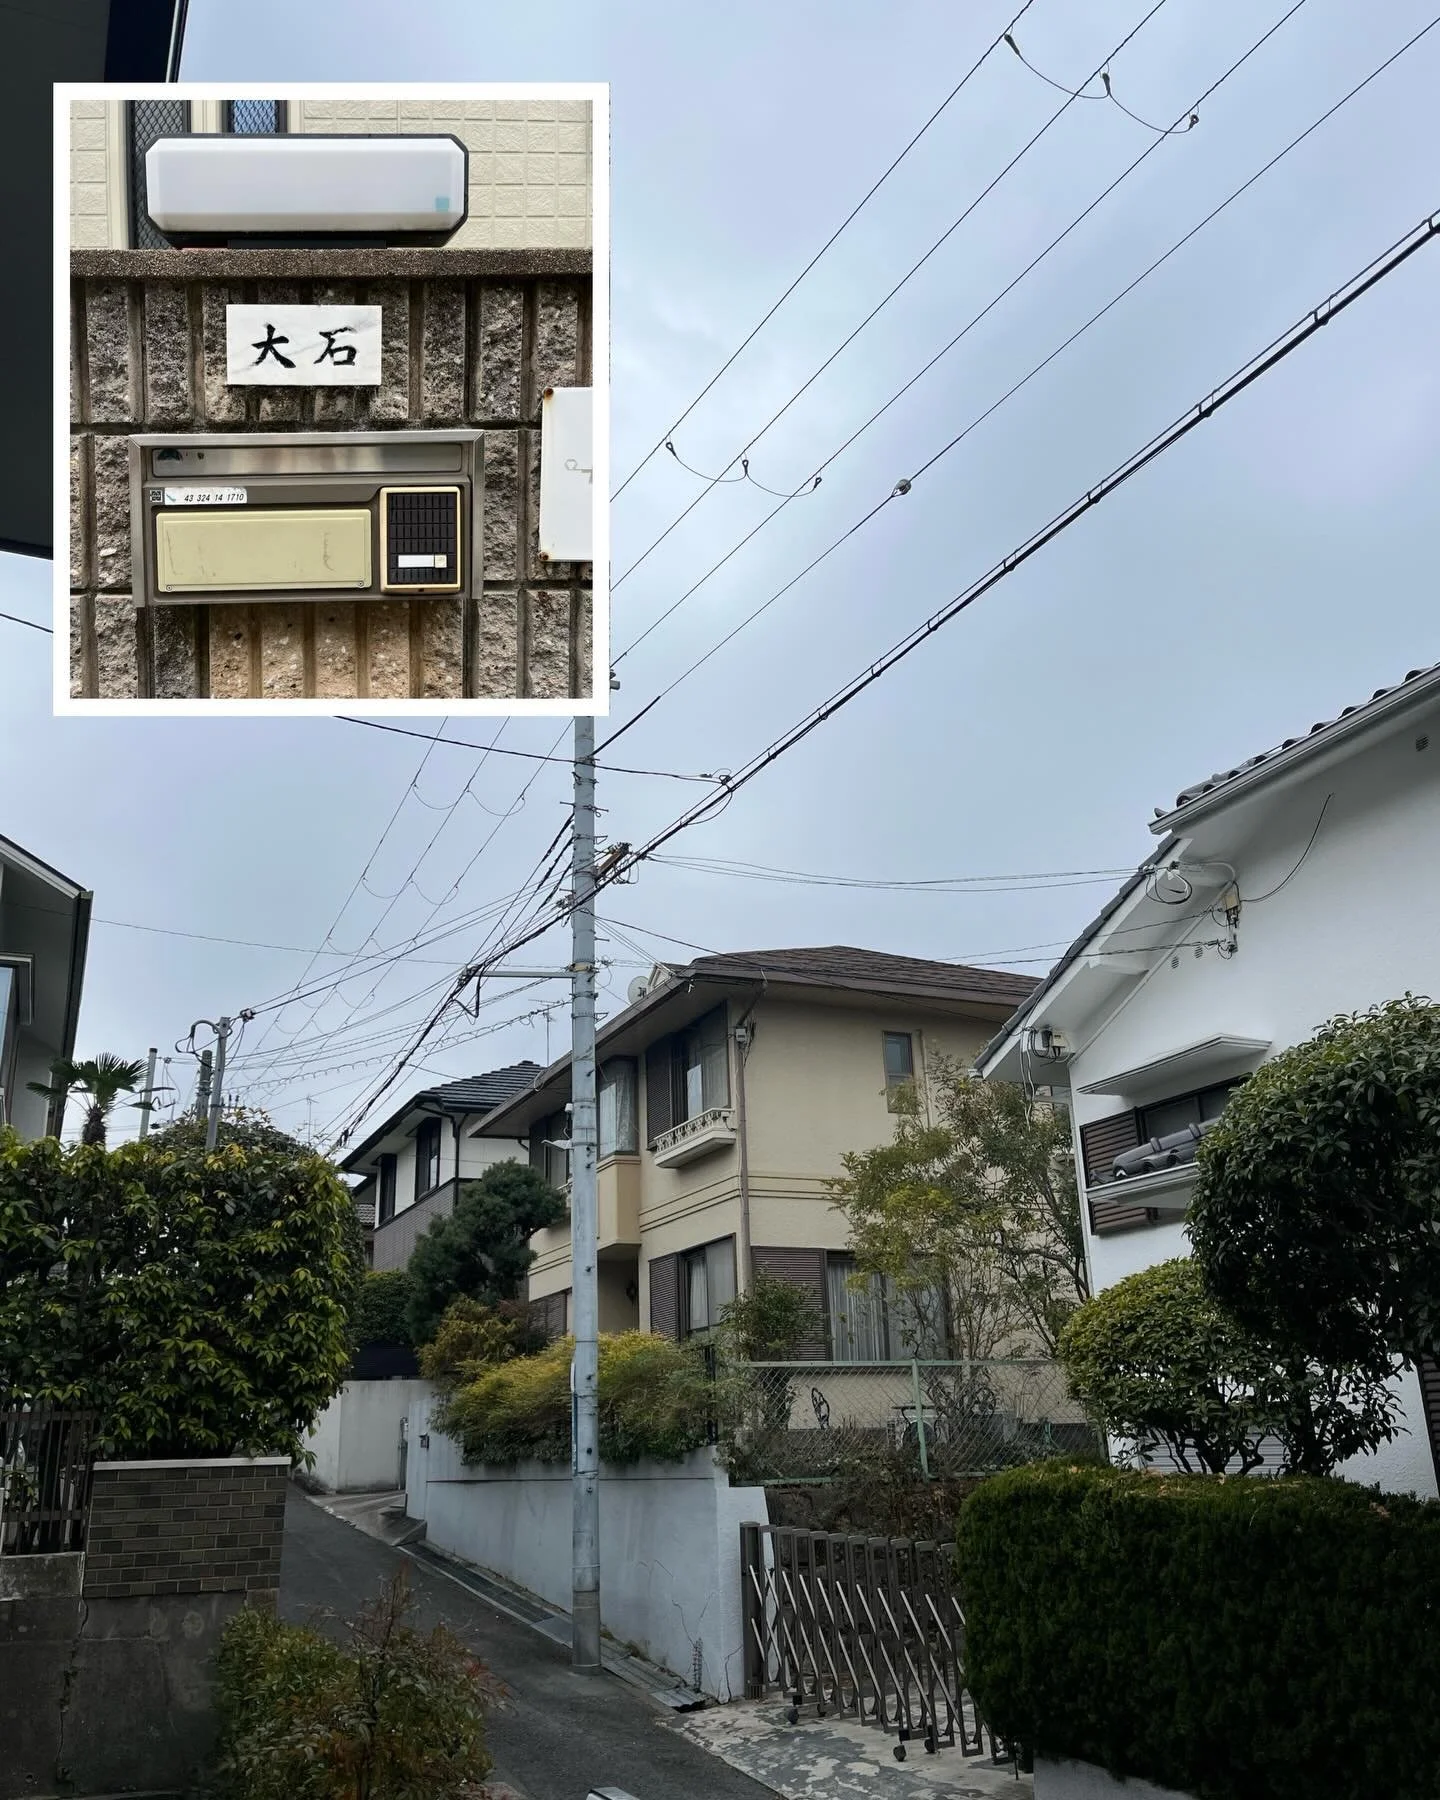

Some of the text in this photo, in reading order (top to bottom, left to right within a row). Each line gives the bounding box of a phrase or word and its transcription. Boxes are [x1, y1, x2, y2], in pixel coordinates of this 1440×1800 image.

[250, 323, 357, 369] 大石
[184, 494, 194, 502] 43
[196, 494, 211, 502] 324
[226, 493, 244, 501] 1710
